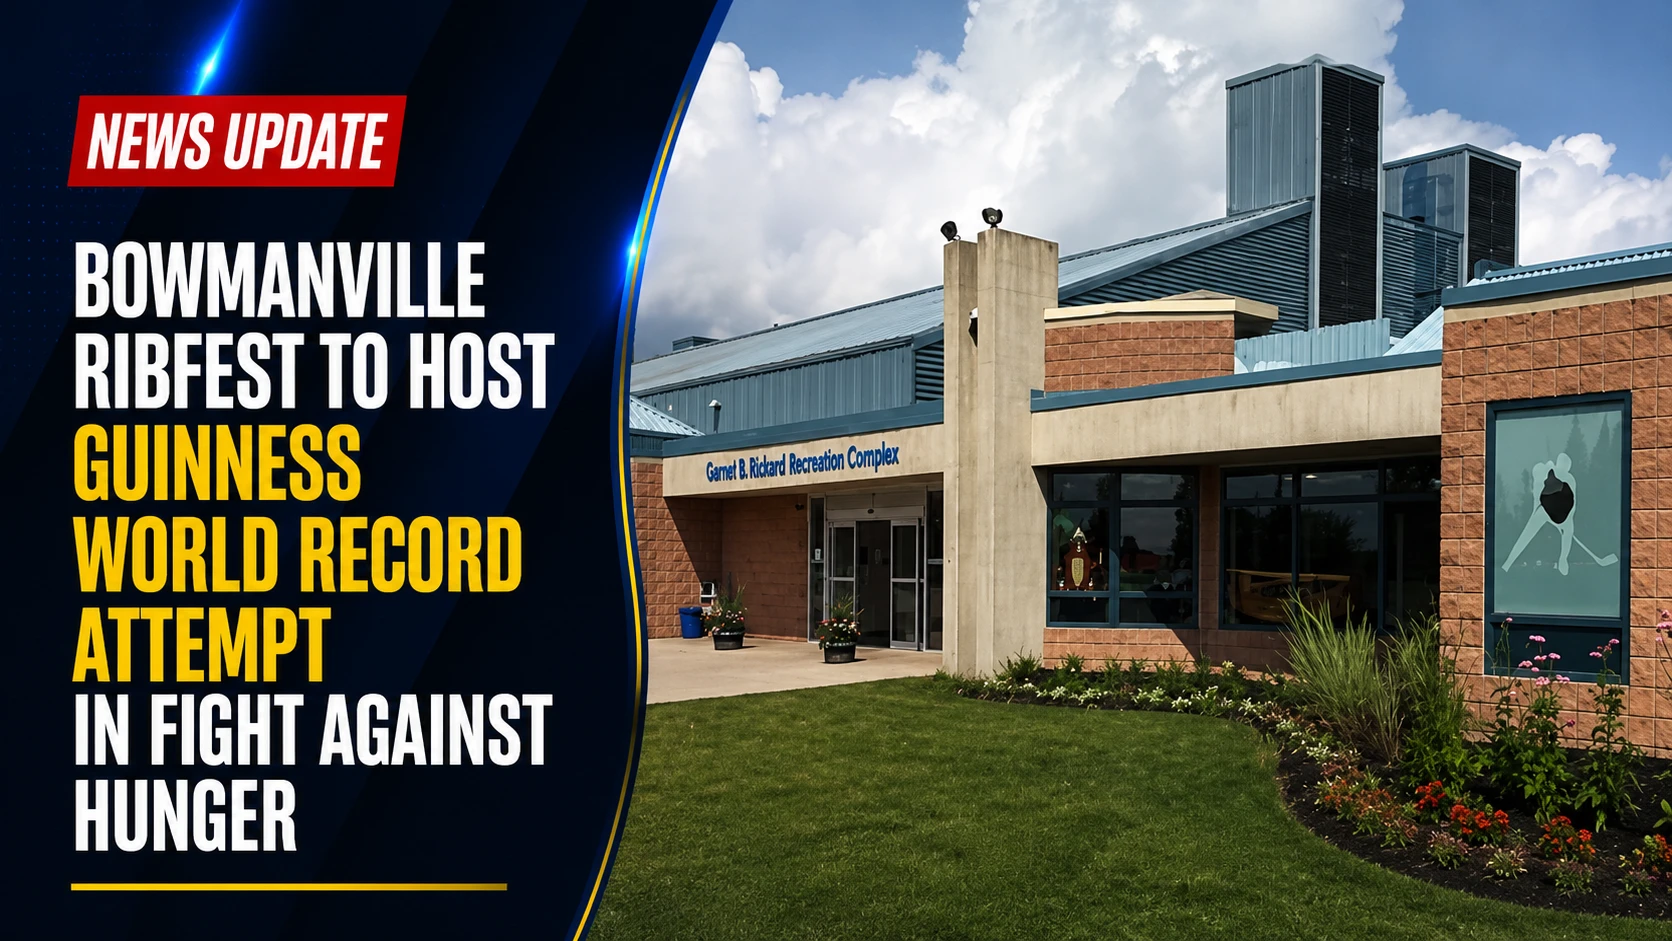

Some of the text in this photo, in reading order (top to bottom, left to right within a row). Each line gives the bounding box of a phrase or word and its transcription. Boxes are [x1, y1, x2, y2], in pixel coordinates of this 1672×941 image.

[706, 441, 899, 483] Garnet B. Rickard Recreation Complex
